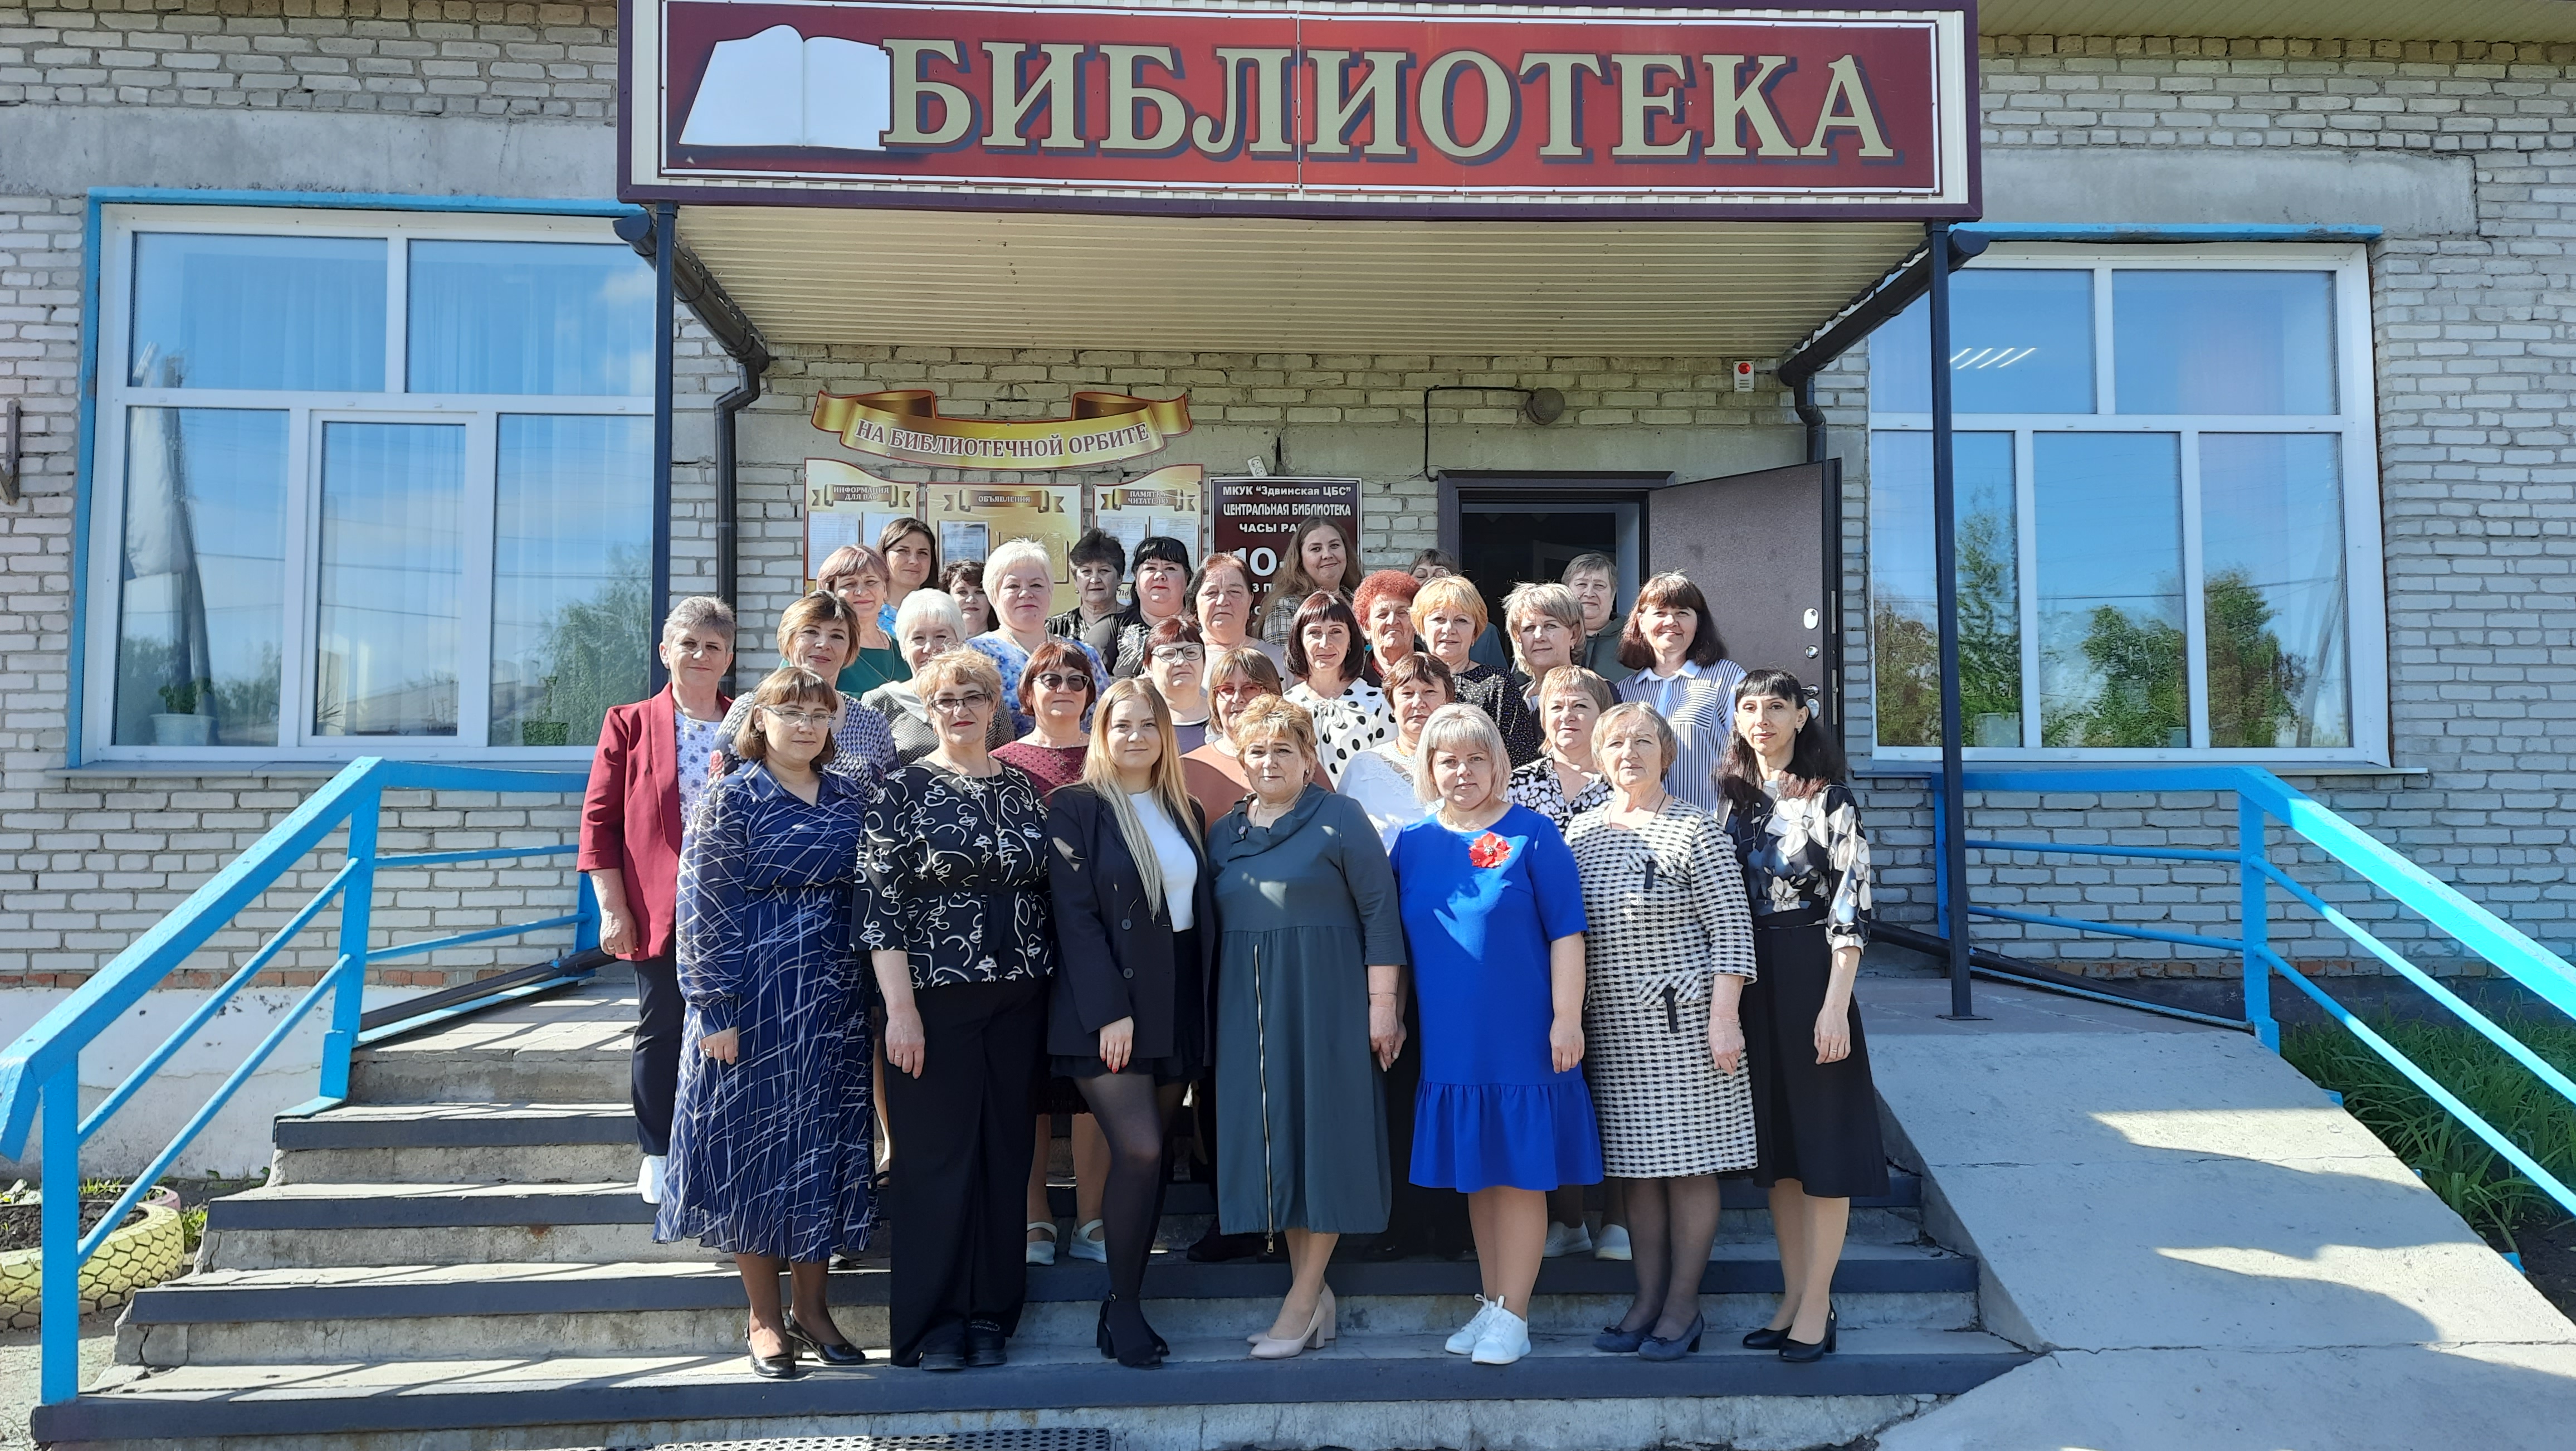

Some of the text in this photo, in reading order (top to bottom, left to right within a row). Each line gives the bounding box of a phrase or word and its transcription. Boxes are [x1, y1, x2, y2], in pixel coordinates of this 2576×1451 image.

[881, 38, 1895, 158] БИБЛИОТЕКА
[856, 418, 1150, 458] НА БИБЛИОТЕЧНОЙ ОРБИТЕ
[1222, 486, 1253, 496] МКУК
[1223, 503, 1352, 516] ЦЕНТРАЛЬНАЯ БИБЛИОТЕКА
[1238, 523, 1277, 533] ЧАСЫ
